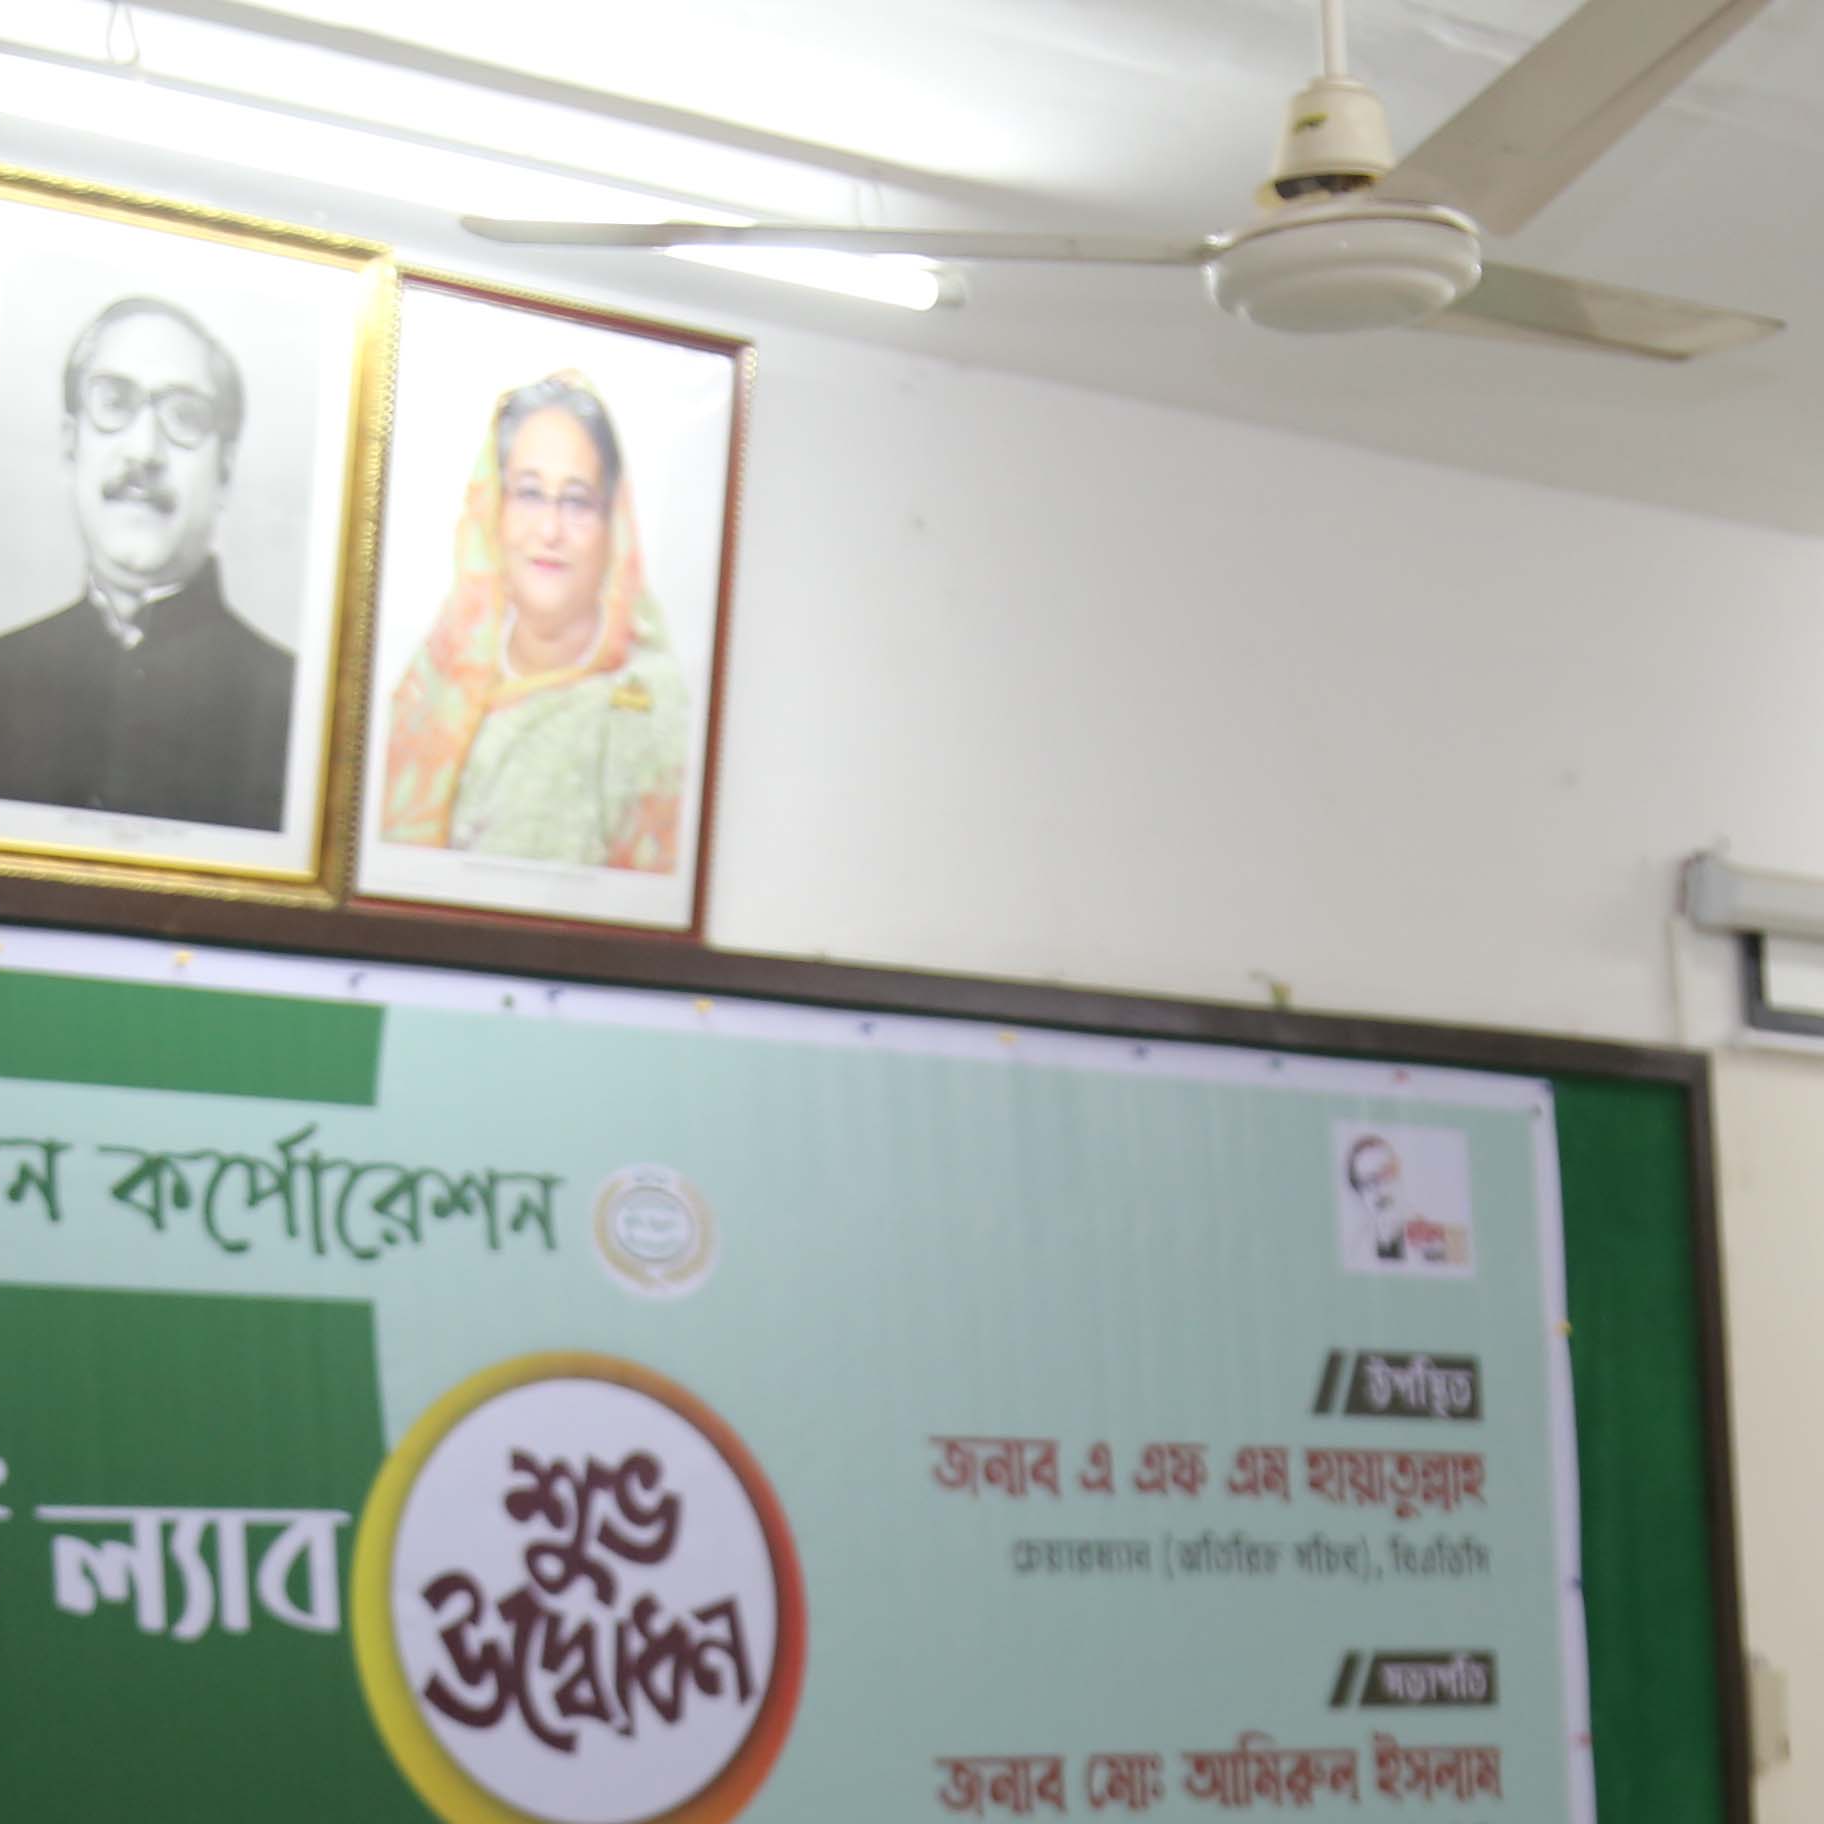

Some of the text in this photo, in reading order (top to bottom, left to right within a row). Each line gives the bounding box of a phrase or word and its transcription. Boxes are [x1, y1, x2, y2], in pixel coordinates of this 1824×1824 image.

[97, 1122, 564, 1260] কর্পোরেশন
[502, 1446, 682, 1603] শুভ
[929, 1435, 1061, 1500] জনাব
[1080, 1440, 1115, 1495] এ
[1132, 1442, 1208, 1498] এফ
[1226, 1445, 1290, 1502] এম
[35, 1504, 352, 1641] ল্যাব
[420, 1570, 754, 1754] উদ্বোধন
[935, 1753, 1067, 1816] জনাব
[1372, 1730, 1503, 1804] ইসলাম
